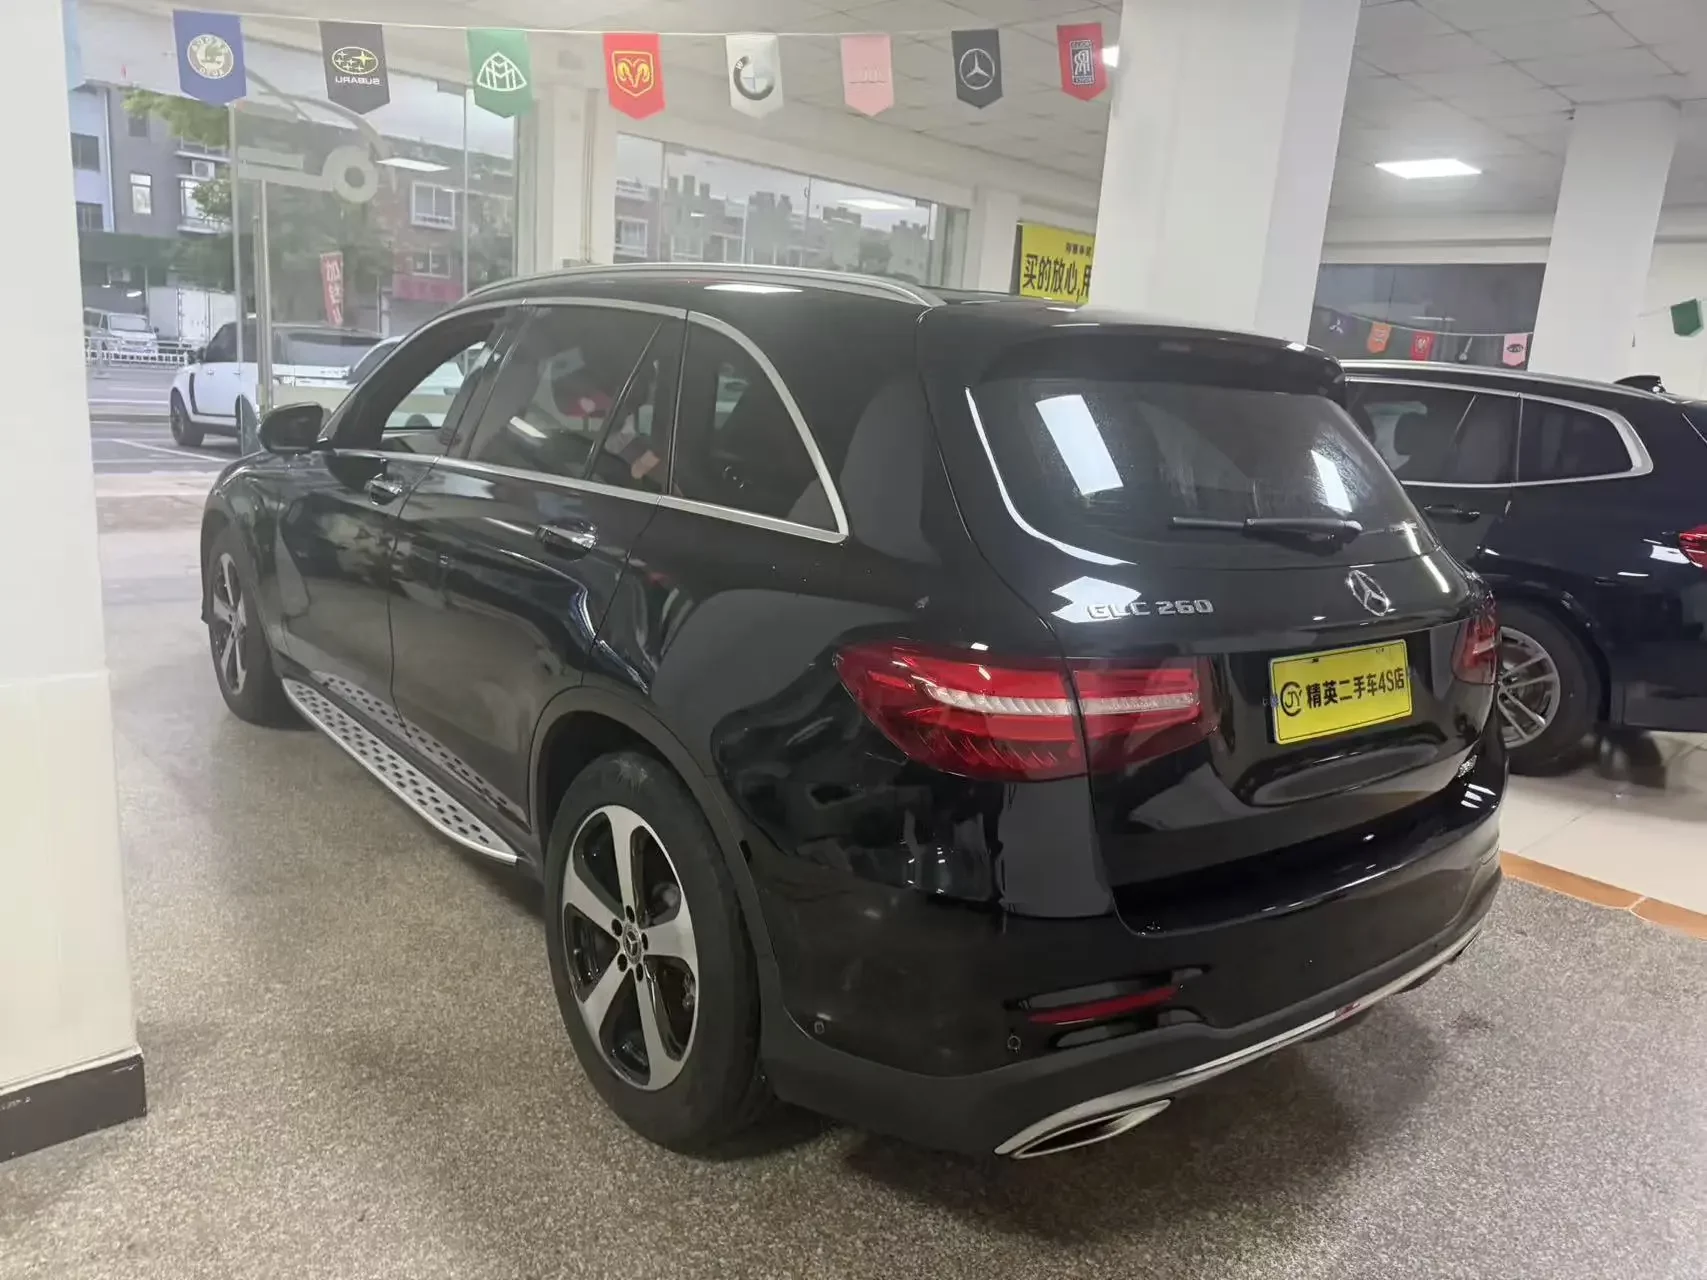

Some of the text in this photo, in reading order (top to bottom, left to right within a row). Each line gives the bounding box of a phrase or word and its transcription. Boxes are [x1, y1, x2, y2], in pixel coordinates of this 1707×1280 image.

[1087, 599, 1213, 619] GLC 260
[1305, 667, 1405, 709] 精英二手车4S店
